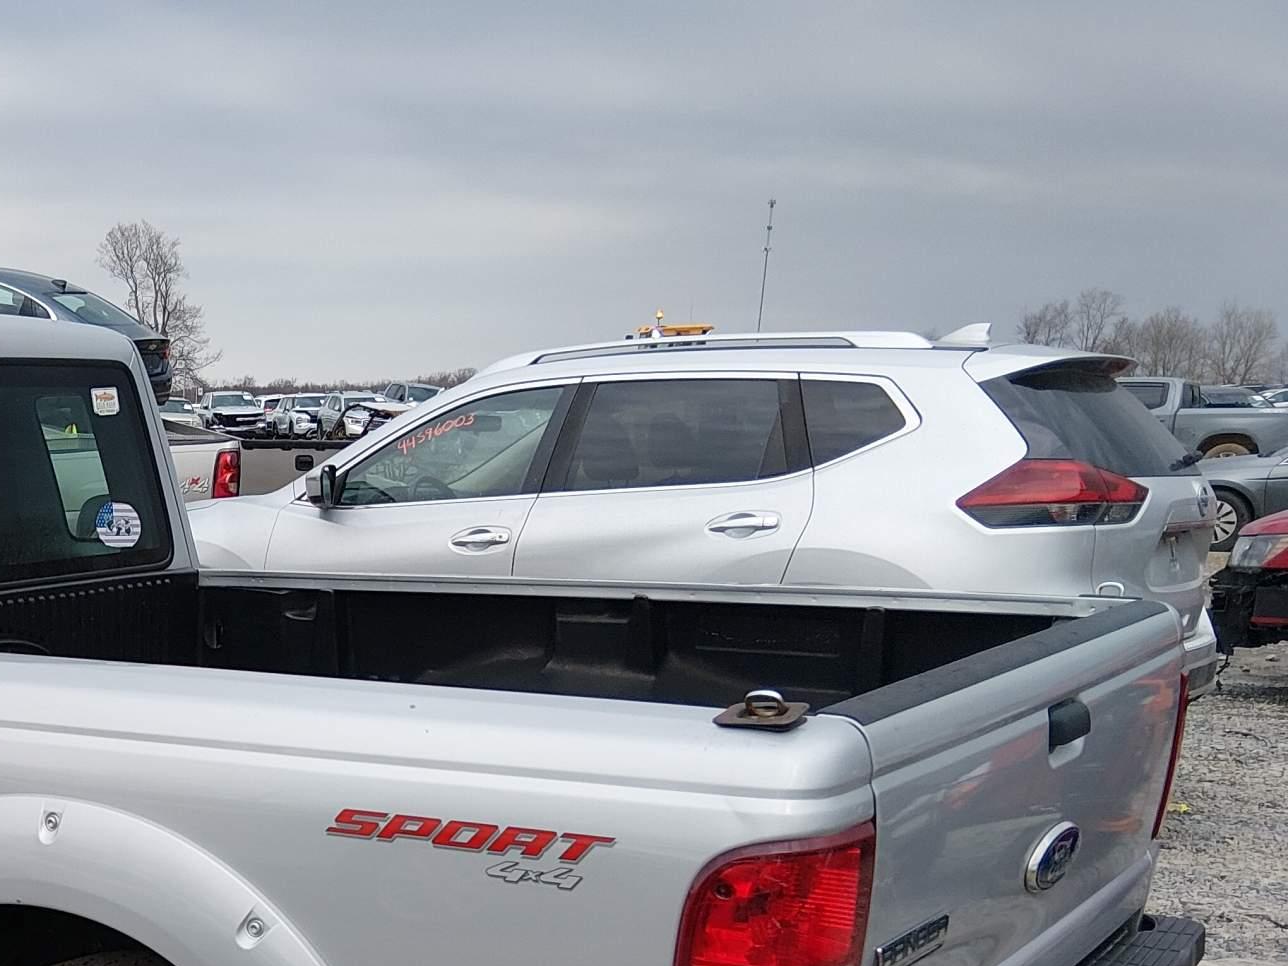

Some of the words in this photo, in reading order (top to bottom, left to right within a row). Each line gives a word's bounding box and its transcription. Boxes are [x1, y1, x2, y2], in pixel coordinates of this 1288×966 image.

[396, 411, 476, 456] 44596003
[325, 808, 617, 865] SPORT
[485, 860, 584, 891] 4x4
